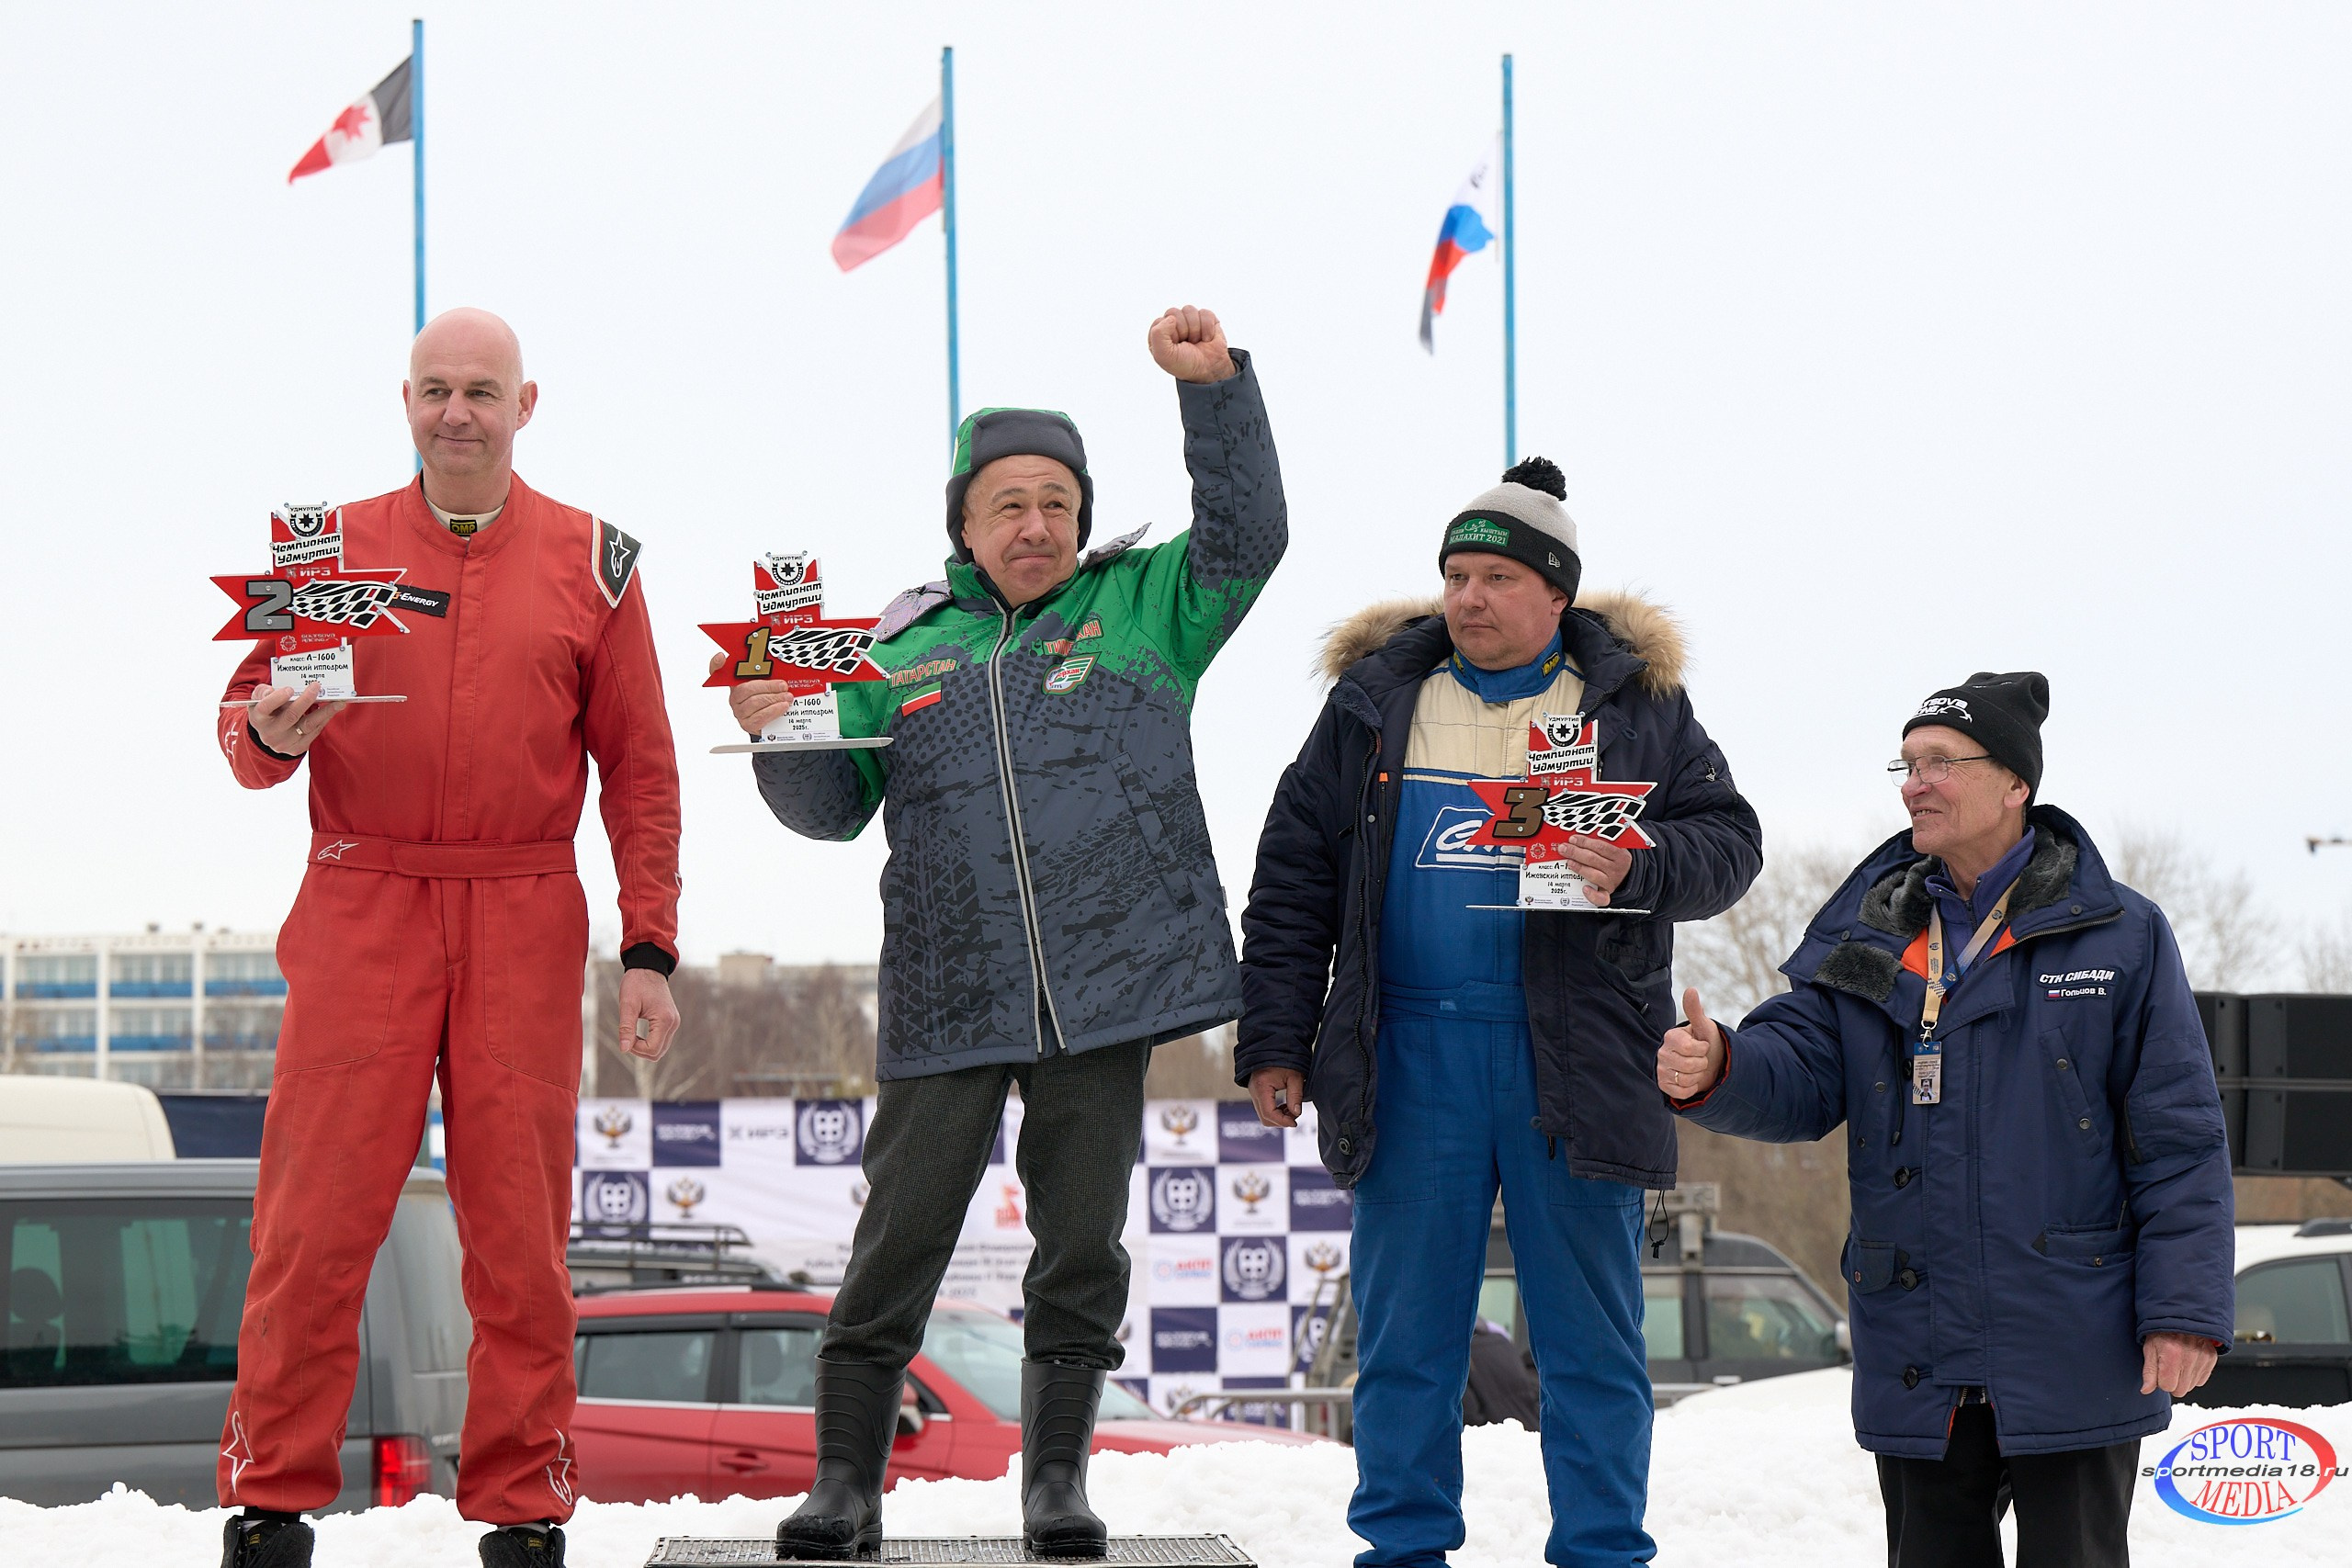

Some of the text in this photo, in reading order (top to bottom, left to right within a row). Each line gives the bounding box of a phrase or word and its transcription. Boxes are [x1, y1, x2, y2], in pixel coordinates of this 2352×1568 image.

[451, 524, 476, 534] OMP
[273, 535, 341, 553] Чемпионат
[1450, 533, 1507, 544] МАЛАХИТ 2021
[300, 567, 331, 577] ИРЗ
[757, 582, 822, 601] Чемпионат
[245, 580, 295, 631] 2
[784, 614, 813, 624] ИРЗ
[735, 626, 774, 679] 1
[890, 659, 956, 687] ТАТАРСТАН
[1529, 746, 1595, 761] Чемпионат
[1554, 776, 1584, 786] ИРЗ
[1492, 787, 1550, 838] 3
[1525, 871, 1559, 879] Ижевский
[2039, 969, 2115, 984] СТК СИБАДИ
[2060, 987, 2107, 997] Гольцов В.
